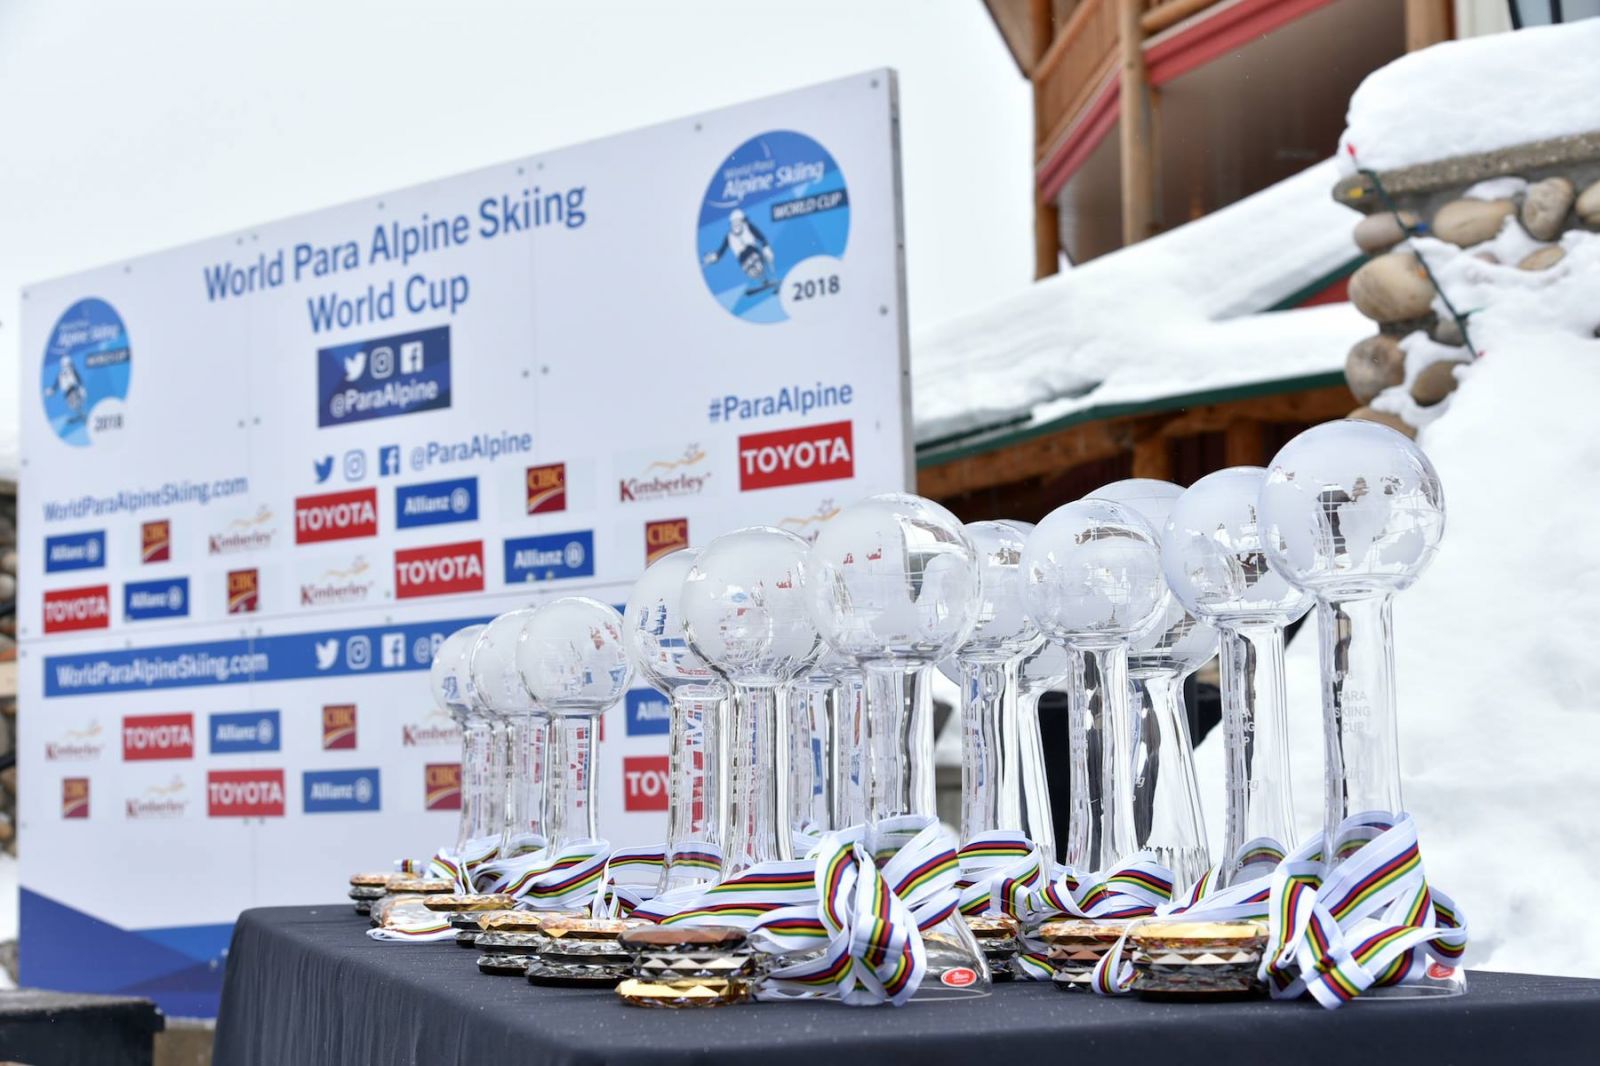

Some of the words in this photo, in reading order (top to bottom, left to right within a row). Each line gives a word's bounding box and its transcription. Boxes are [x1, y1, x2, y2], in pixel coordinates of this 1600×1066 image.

[773, 196, 816, 220] WORLD
[817, 191, 843, 212] CUP
[204, 249, 284, 302] World
[294, 240, 360, 283] Para
[369, 213, 470, 267] Alpine
[479, 186, 586, 239] Skiing
[308, 281, 395, 334] World
[405, 273, 469, 315] Cup
[793, 275, 841, 302] 2018
[330, 379, 438, 418] @ParaAlpine
[709, 383, 853, 423] #ParaAlpine
[411, 432, 532, 471] @ParaAlpine
[741, 437, 850, 475] TOYOTA
[43, 476, 248, 522] WorldParaAlpineSkiing.com
[619, 473, 704, 502] Kimberley
[296, 501, 376, 532] TOYOTA
[404, 495, 451, 516] Allianz
[647, 522, 686, 546] CIBC
[397, 554, 483, 585] TOYOTA
[513, 548, 563, 569] Allianz
[45, 596, 109, 623] TOYOTA
[56, 651, 268, 688] WorldParaAlpineSkiing.com
[124, 723, 193, 749] TOYOTA
[209, 780, 283, 806] TOYOTA
[626, 770, 669, 797] TOY
